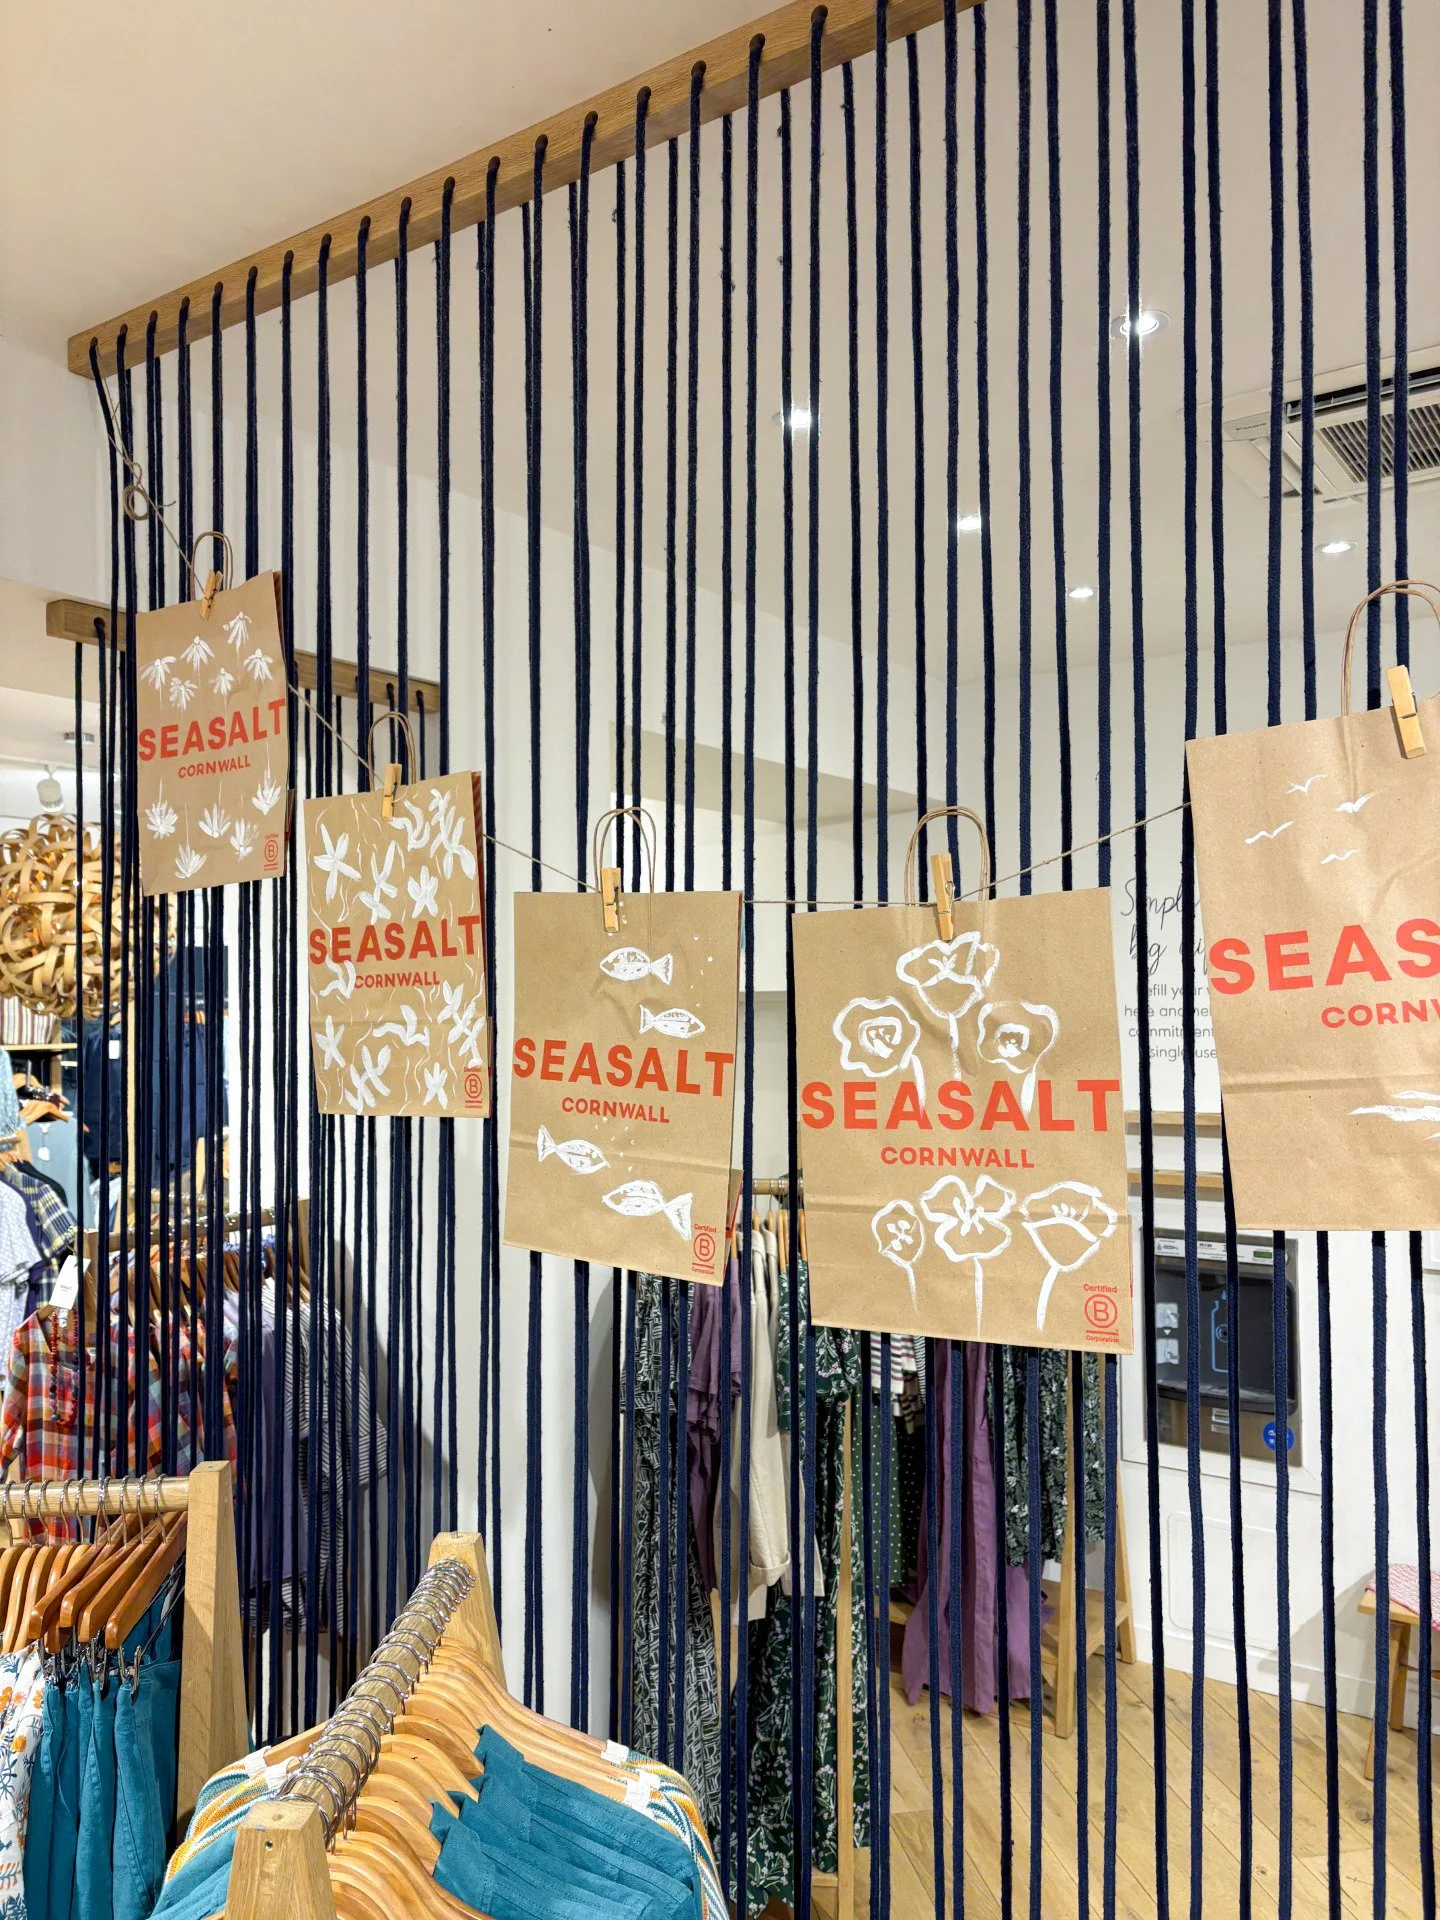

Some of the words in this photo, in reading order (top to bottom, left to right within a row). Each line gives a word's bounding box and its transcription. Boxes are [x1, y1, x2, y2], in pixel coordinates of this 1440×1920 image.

[138, 698, 286, 762] SEASALT
[178, 755, 251, 779] CORNWALL
[309, 915, 481, 965] SEASALT
[354, 971, 440, 989] CORNWALL
[1320, 998, 1440, 1029] CORN
[513, 1037, 734, 1097] SEASALT
[561, 1096, 670, 1124] CORNWALL
[801, 1079, 1121, 1133] SEASALT
[879, 1146, 1035, 1169] CORNWALL
[1083, 1283, 1117, 1293] Certified
